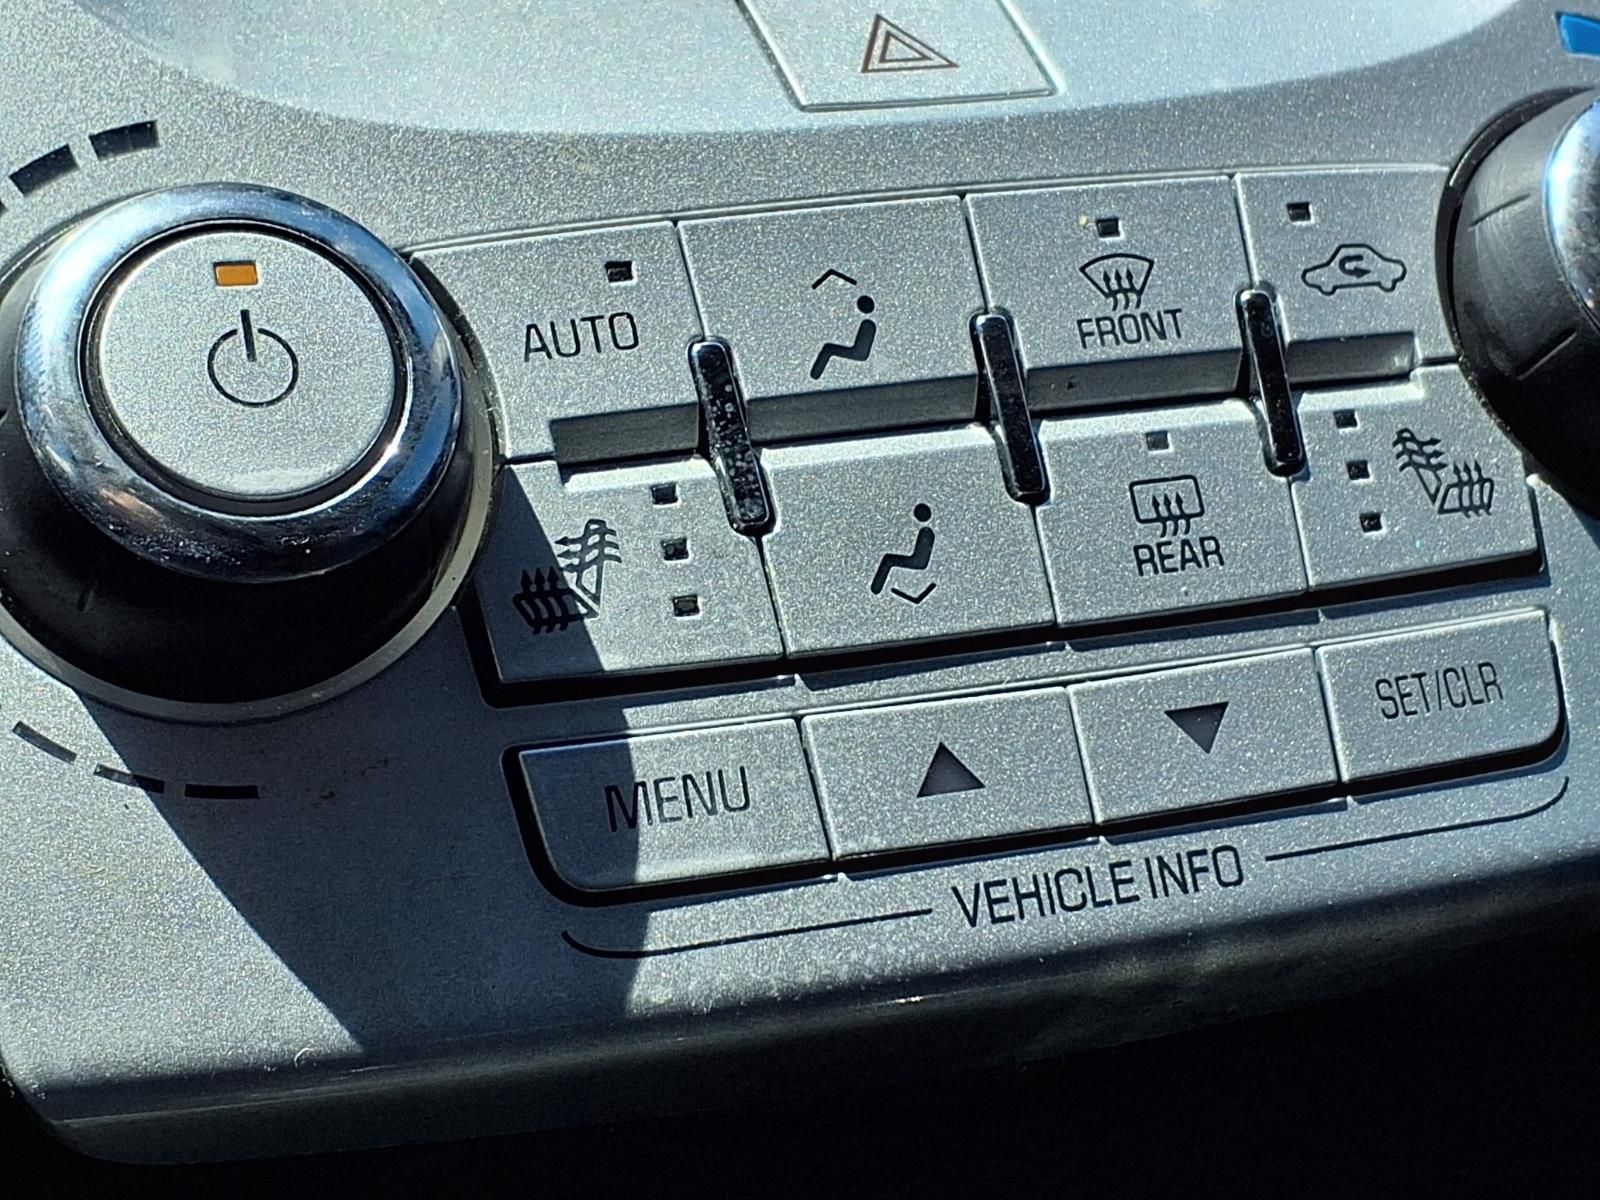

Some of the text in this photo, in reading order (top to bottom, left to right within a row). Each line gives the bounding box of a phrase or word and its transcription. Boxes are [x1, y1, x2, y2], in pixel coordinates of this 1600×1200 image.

[523, 311, 640, 363] AUTO
[1076, 307, 1184, 349] FRONT
[1133, 535, 1225, 577] REAR
[1374, 661, 1504, 721] SET/CLR
[603, 765, 752, 833] MENU
[951, 844, 1245, 928] VEHICLE INFO
